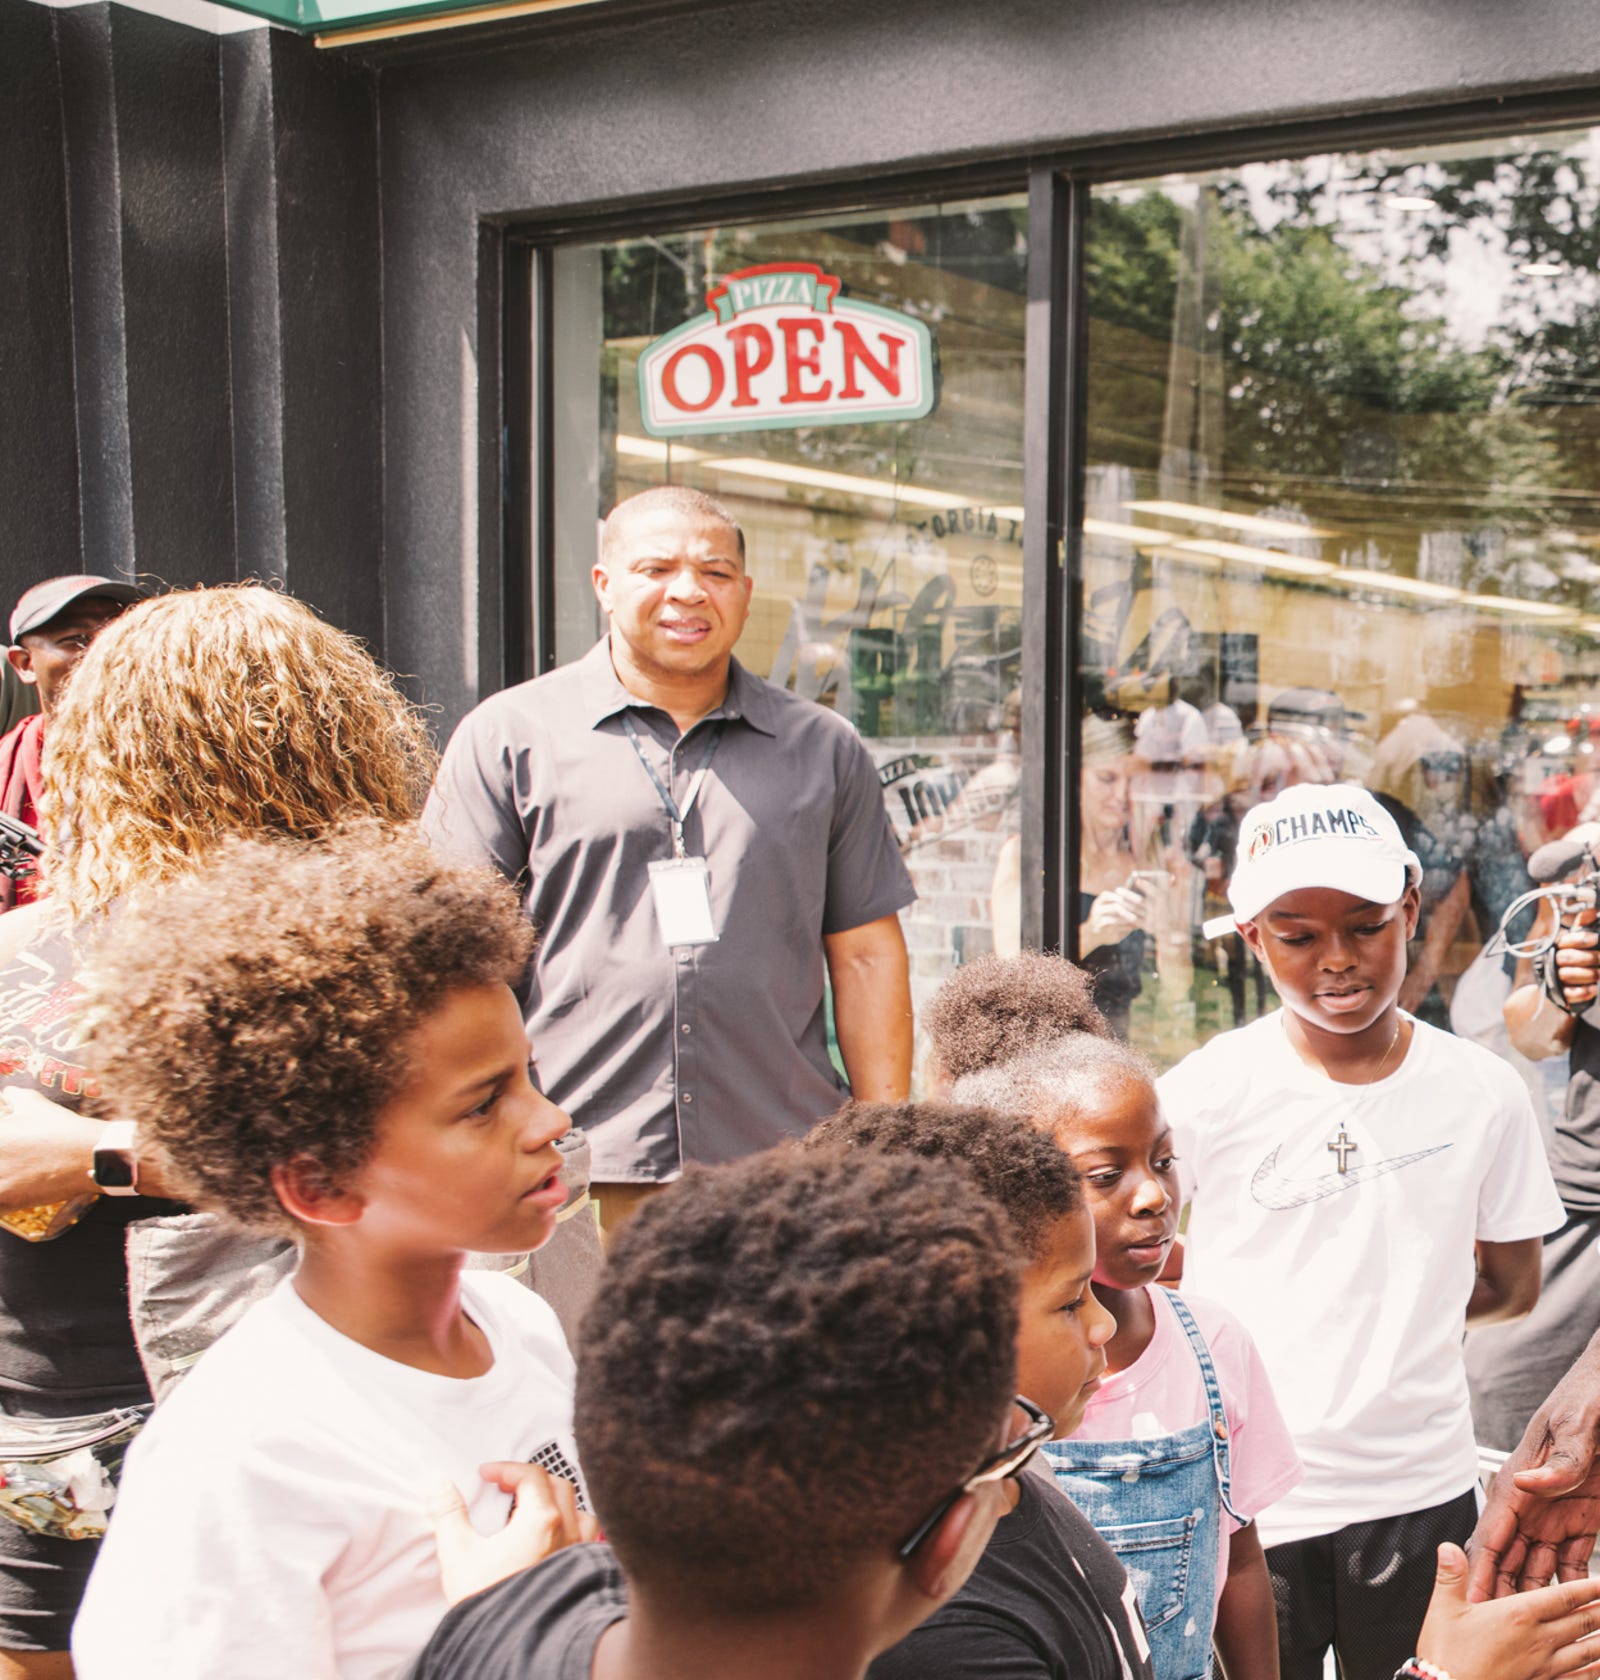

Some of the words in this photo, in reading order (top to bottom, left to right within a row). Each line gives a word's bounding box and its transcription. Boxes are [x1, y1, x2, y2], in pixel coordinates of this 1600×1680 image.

[733, 276, 814, 311] PIZZA
[661, 317, 906, 413] OPEN
[1276, 808, 1378, 845] CHAMPS
